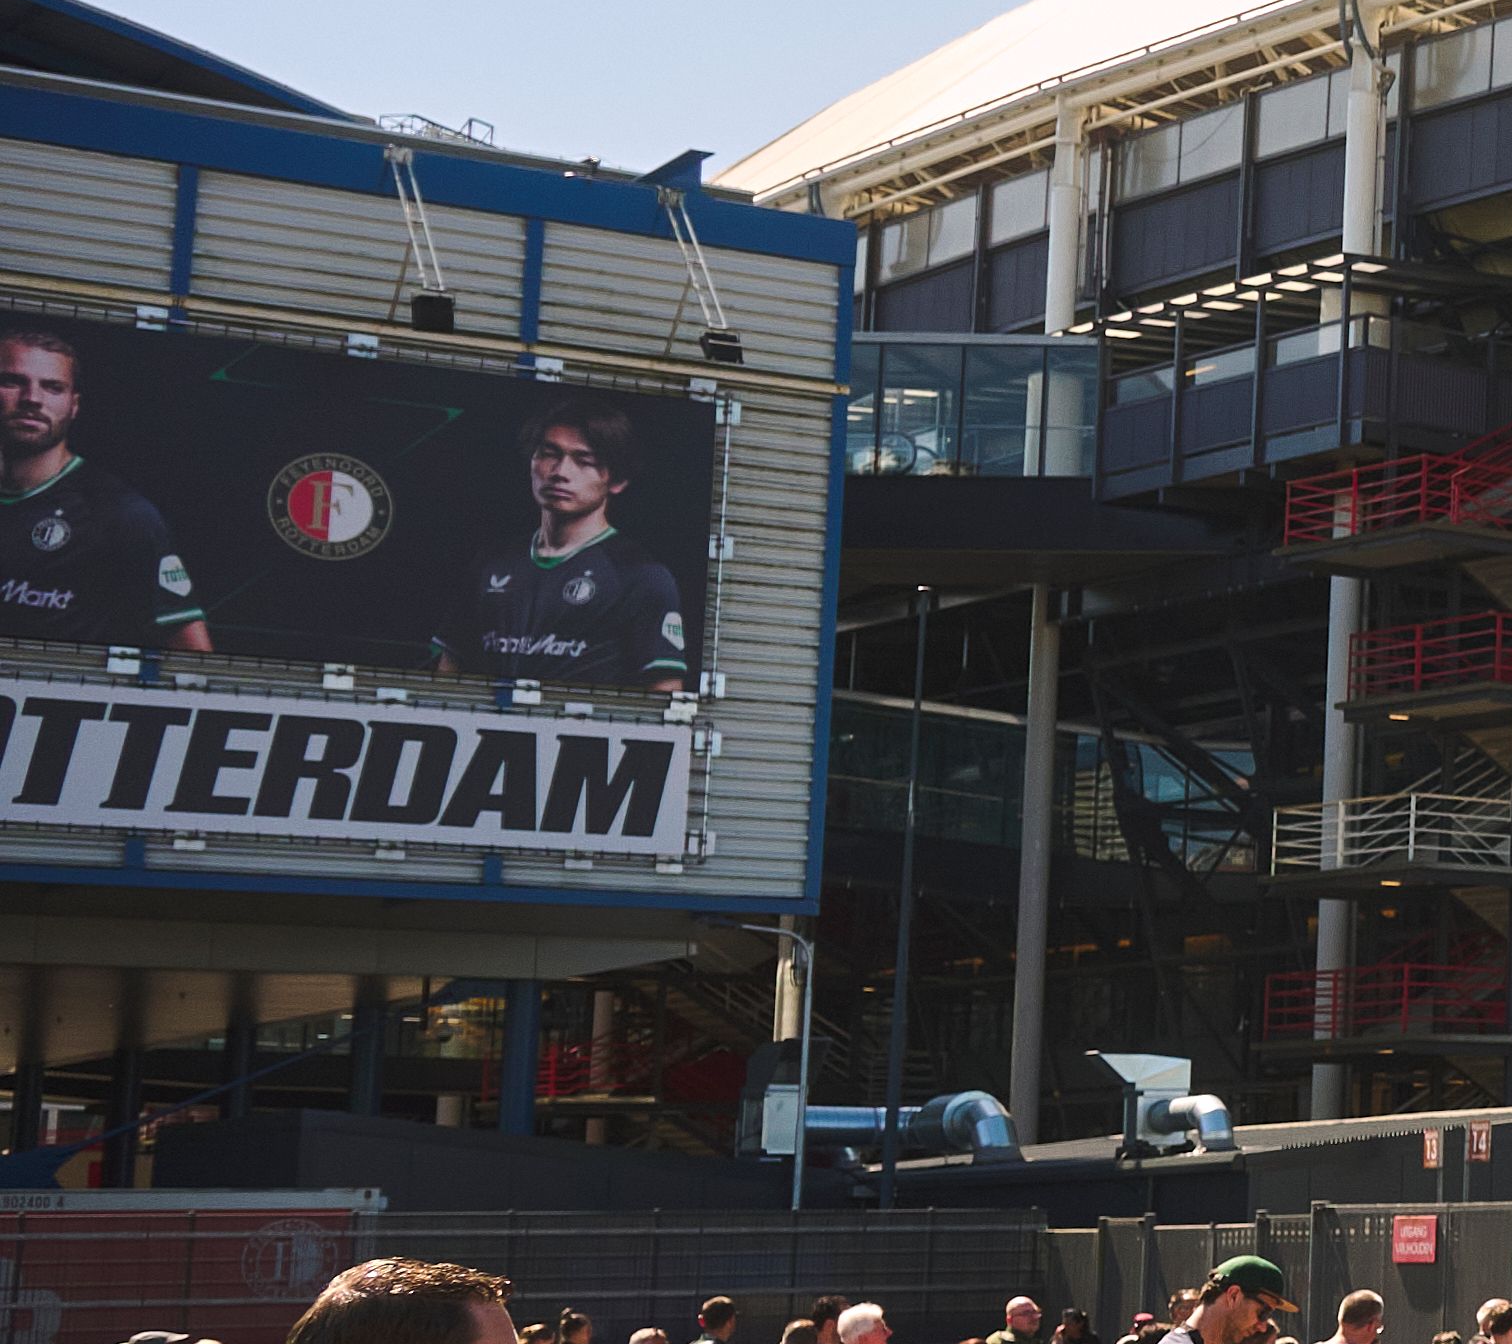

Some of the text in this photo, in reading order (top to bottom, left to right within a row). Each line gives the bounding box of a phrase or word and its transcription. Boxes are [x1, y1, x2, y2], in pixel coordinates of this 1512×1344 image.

[0, 697, 670, 838] TTERDAM
[1426, 1138, 1437, 1160] 13
[1473, 1131, 1486, 1152] 14
